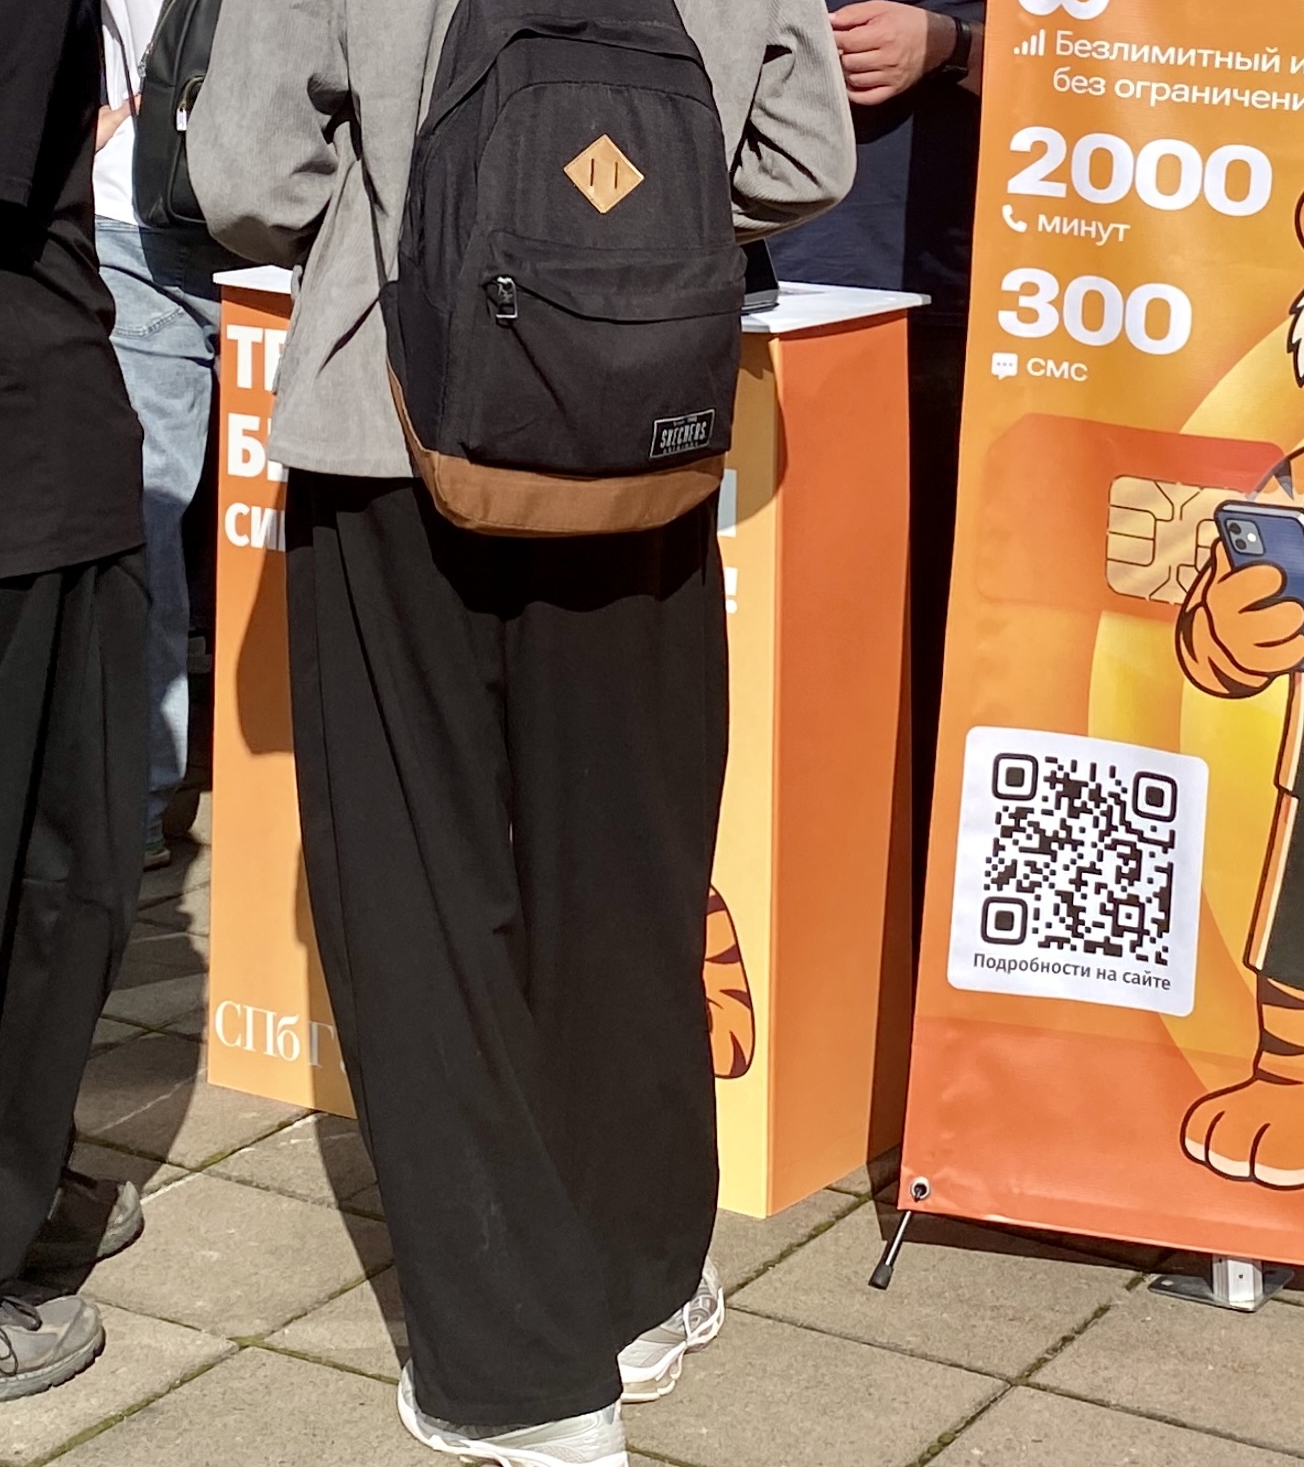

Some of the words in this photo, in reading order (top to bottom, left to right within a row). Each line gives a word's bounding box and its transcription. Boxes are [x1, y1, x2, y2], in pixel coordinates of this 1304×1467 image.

[1055, 30, 1281, 74] Безлимитный
[1052, 66, 1106, 96] без
[1006, 126, 1273, 216] 2000
[1037, 213, 1131, 246] минут
[997, 267, 1193, 355] 300
[973, 953, 1091, 978] Подробности
[1096, 968, 1117, 981] на
[1123, 969, 1171, 991] сайте
[215, 1000, 346, 1075] СПбГ
